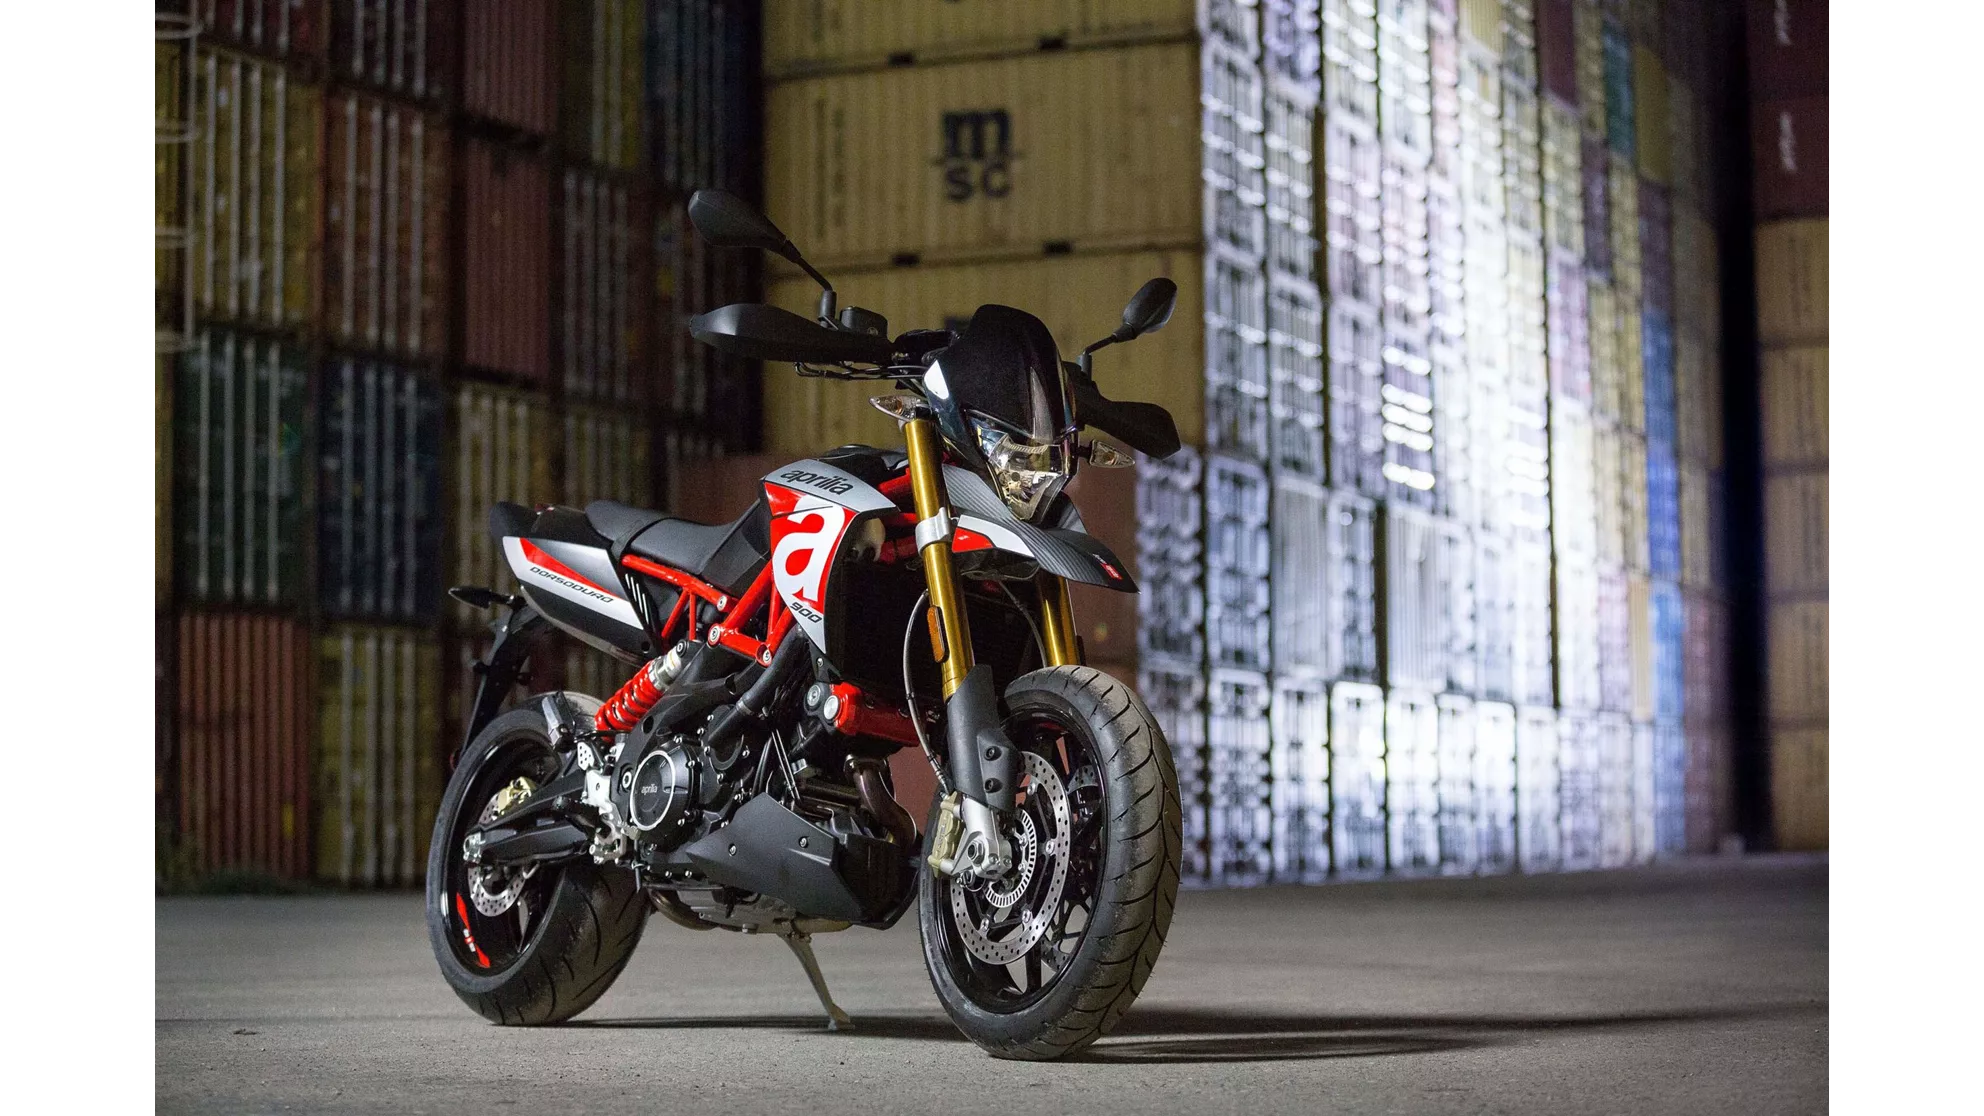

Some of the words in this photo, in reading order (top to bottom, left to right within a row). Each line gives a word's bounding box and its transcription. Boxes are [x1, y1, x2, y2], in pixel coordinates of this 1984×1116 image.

[780, 469, 854, 495] aprilia
[530, 566, 614, 603] DORSODURO
[790, 602, 822, 623] 900
[641, 783, 658, 795] aprilia
